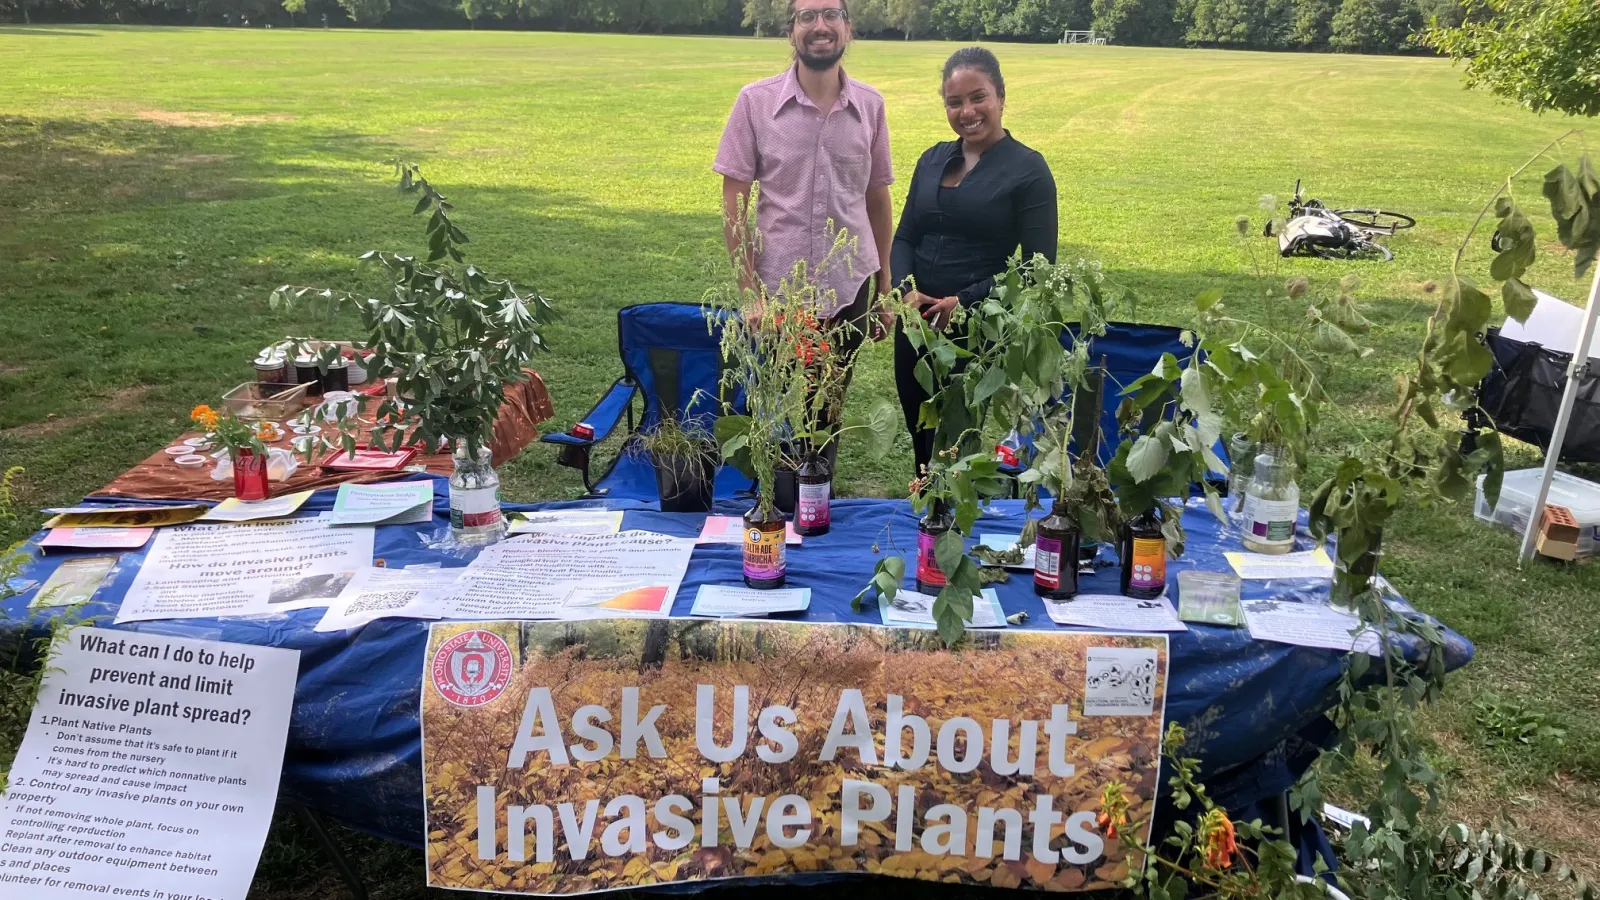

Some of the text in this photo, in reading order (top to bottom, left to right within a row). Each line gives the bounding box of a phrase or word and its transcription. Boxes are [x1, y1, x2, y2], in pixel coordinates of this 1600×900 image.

[232, 557, 294, 566] invasive
[299, 550, 348, 561] plants
[246, 563, 312, 574] around?
[744, 552, 772, 564] MBUCHA
[80, 634, 255, 673] What can I do to help
[434, 634, 509, 685] OHIO STATE UNIVERSITY
[90, 667, 234, 696] prevent and limit
[58, 688, 251, 725] invasive plant spread?
[455, 696, 485, 704] 1870
[40, 715, 152, 736] 1.Plant Native Plants
[506, 684, 1078, 778] Ask Us About
[53, 746, 166, 765] comes from the nursery
[57, 732, 83, 742] Don't
[85, 736, 121, 746] assume
[124, 739, 144, 749] that
[146, 741, 160, 750] it's
[162, 744, 182, 752] safe
[185, 746, 194, 754] to
[196, 747, 220, 757] plant
[230, 750, 237, 758] it
[42, 769, 63, 778] may
[65, 772, 100, 782] spread
[153, 781, 187, 792] impact
[47, 756, 62, 765] It's
[65, 759, 88, 768] hard
[101, 764, 137, 774] predict
[139, 767, 167, 777] which
[169, 771, 216, 782] nonnative
[218, 776, 247, 786] plants
[9, 792, 56, 805] property
[29, 779, 71, 792] Control
[73, 785, 93, 796] any
[96, 788, 139, 801] invasive
[142, 794, 177, 805] plants
[195, 801, 220, 810] your
[222, 804, 244, 813] own
[11, 819, 125, 838] controlling reprduction
[16, 805, 24, 813] If
[44, 809, 93, 823] removing
[94, 816, 124, 825] whole
[125, 820, 154, 830] plant,
[157, 823, 184, 834] focus
[476, 777, 1104, 864] Invasive Plants
[5, 830, 212, 861] Replant after removal to enhance habitat
[1, 843, 218, 876] Clean any outdoor equipment between
[9, 860, 31, 869] and
[32, 862, 71, 874] places
[44, 877, 61, 887] for
[63, 880, 110, 894] removal
[113, 887, 150, 898] events
[153, 890, 164, 899] in
